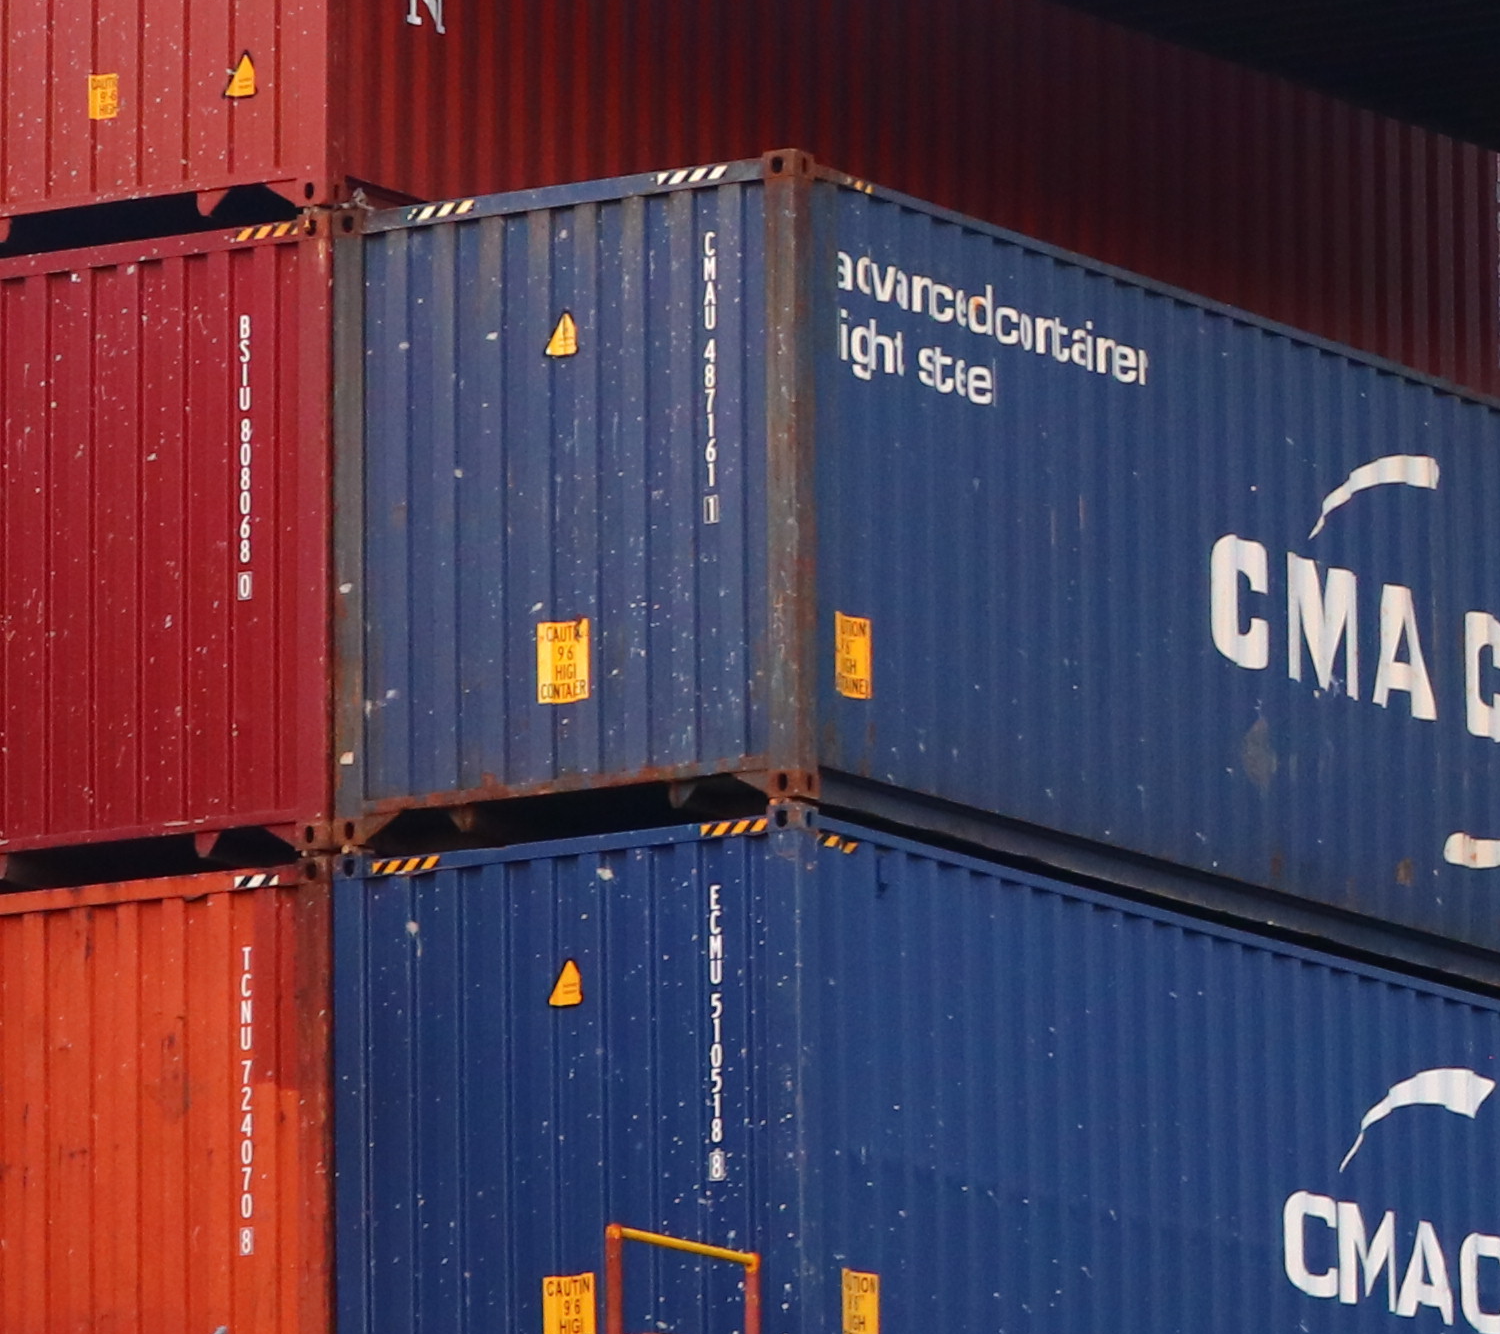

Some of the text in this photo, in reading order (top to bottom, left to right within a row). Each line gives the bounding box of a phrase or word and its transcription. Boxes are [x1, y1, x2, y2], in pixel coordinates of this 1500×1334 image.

[703, 231, 718, 525] CMAU 487161 1
[838, 309, 997, 407] ight stee
[238, 315, 253, 601] BSIU 808068 0
[1209, 533, 1438, 721] CMA
[709, 884, 724, 985] ECMU
[239, 946, 254, 1256] TCNU 724070 8
[710, 992, 724, 1143] 510518
[546, 1278, 591, 1299] CAUTIN
[1282, 1190, 1454, 1326] CMA
